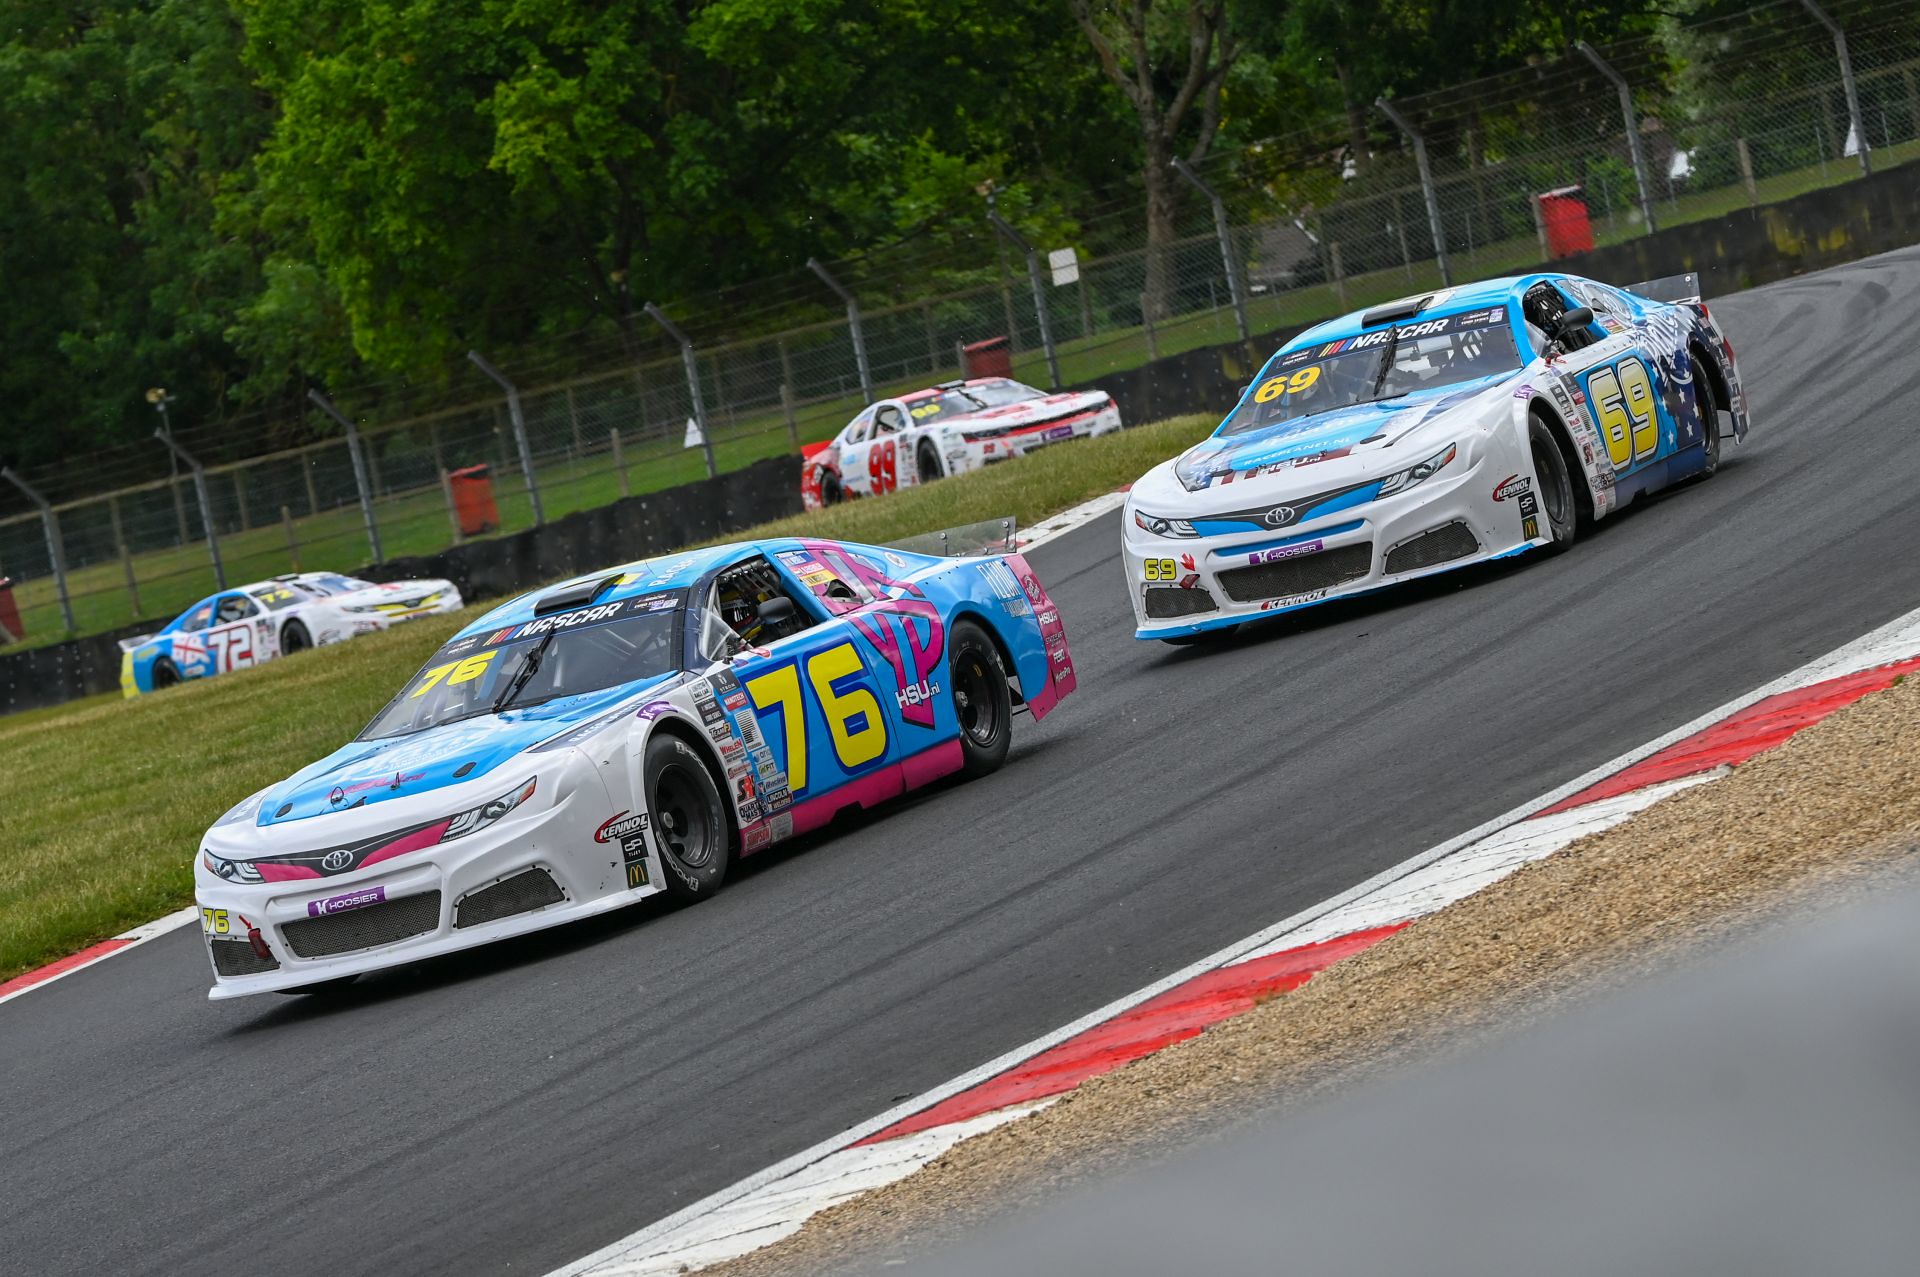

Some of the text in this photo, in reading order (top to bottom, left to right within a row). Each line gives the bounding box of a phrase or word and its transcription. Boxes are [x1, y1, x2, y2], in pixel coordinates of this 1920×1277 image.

[1349, 318, 1449, 351] NASCAR
[1254, 367, 1321, 403] 69
[1588, 356, 1659, 471] 69
[868, 438, 897, 496] 99
[1497, 479, 1529, 498] KENNOL
[1271, 544, 1317, 560] HOOSIER
[1144, 558, 1177, 581] 69
[259, 589, 295, 604] 72
[1267, 589, 1327, 610] KENNOL
[513, 601, 624, 639] NASCAR
[207, 626, 254, 674] 72
[411, 650, 499, 700] 76
[895, 679, 941, 709] HSU.nl
[744, 641, 888, 792] 76
[720, 739, 742, 754] WHELEN
[768, 788, 788, 803] LINCOLN
[600, 814, 648, 840] KENNOL
[329, 893, 379, 910] HOOSIER
[203, 907, 230, 934] 76
